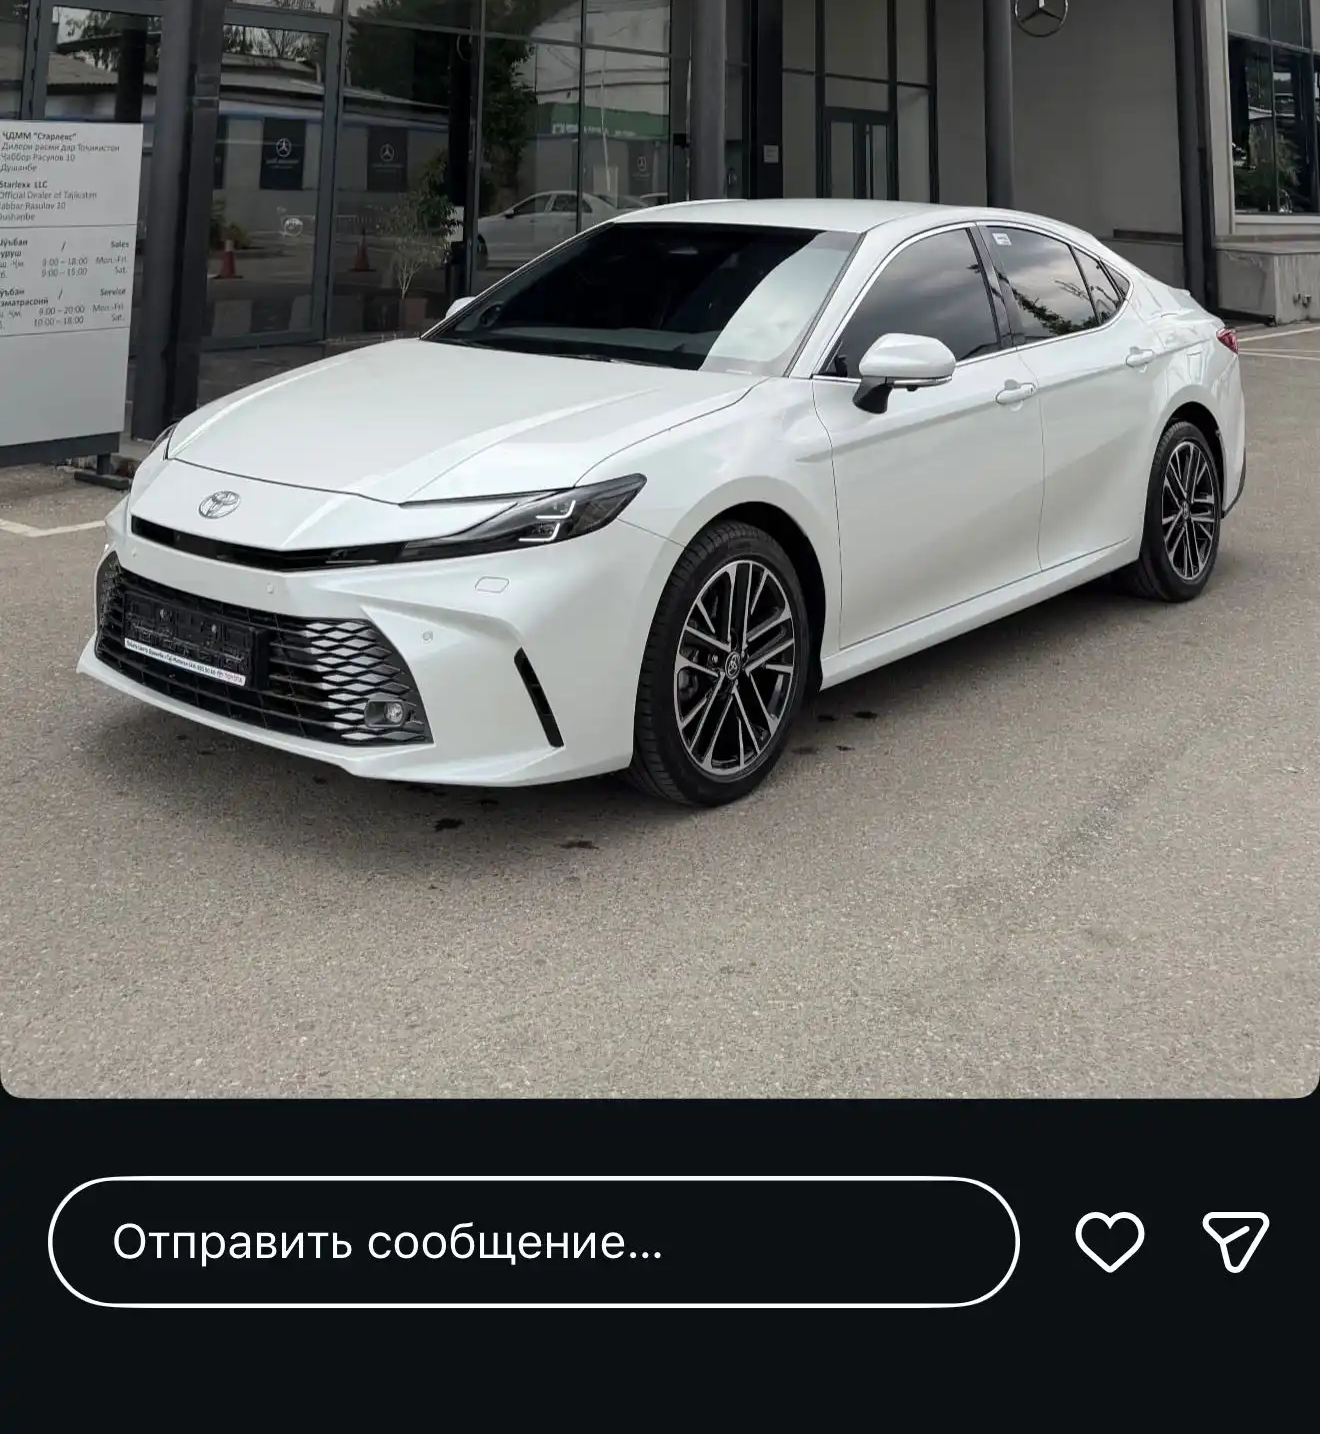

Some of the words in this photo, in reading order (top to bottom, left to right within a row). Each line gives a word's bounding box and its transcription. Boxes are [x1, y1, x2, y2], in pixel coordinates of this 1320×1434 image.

[34, 180, 48, 189] LLC
[53, 190, 62, 199] of
[111, 240, 129, 248] Sales
[100, 287, 126, 296] Service
